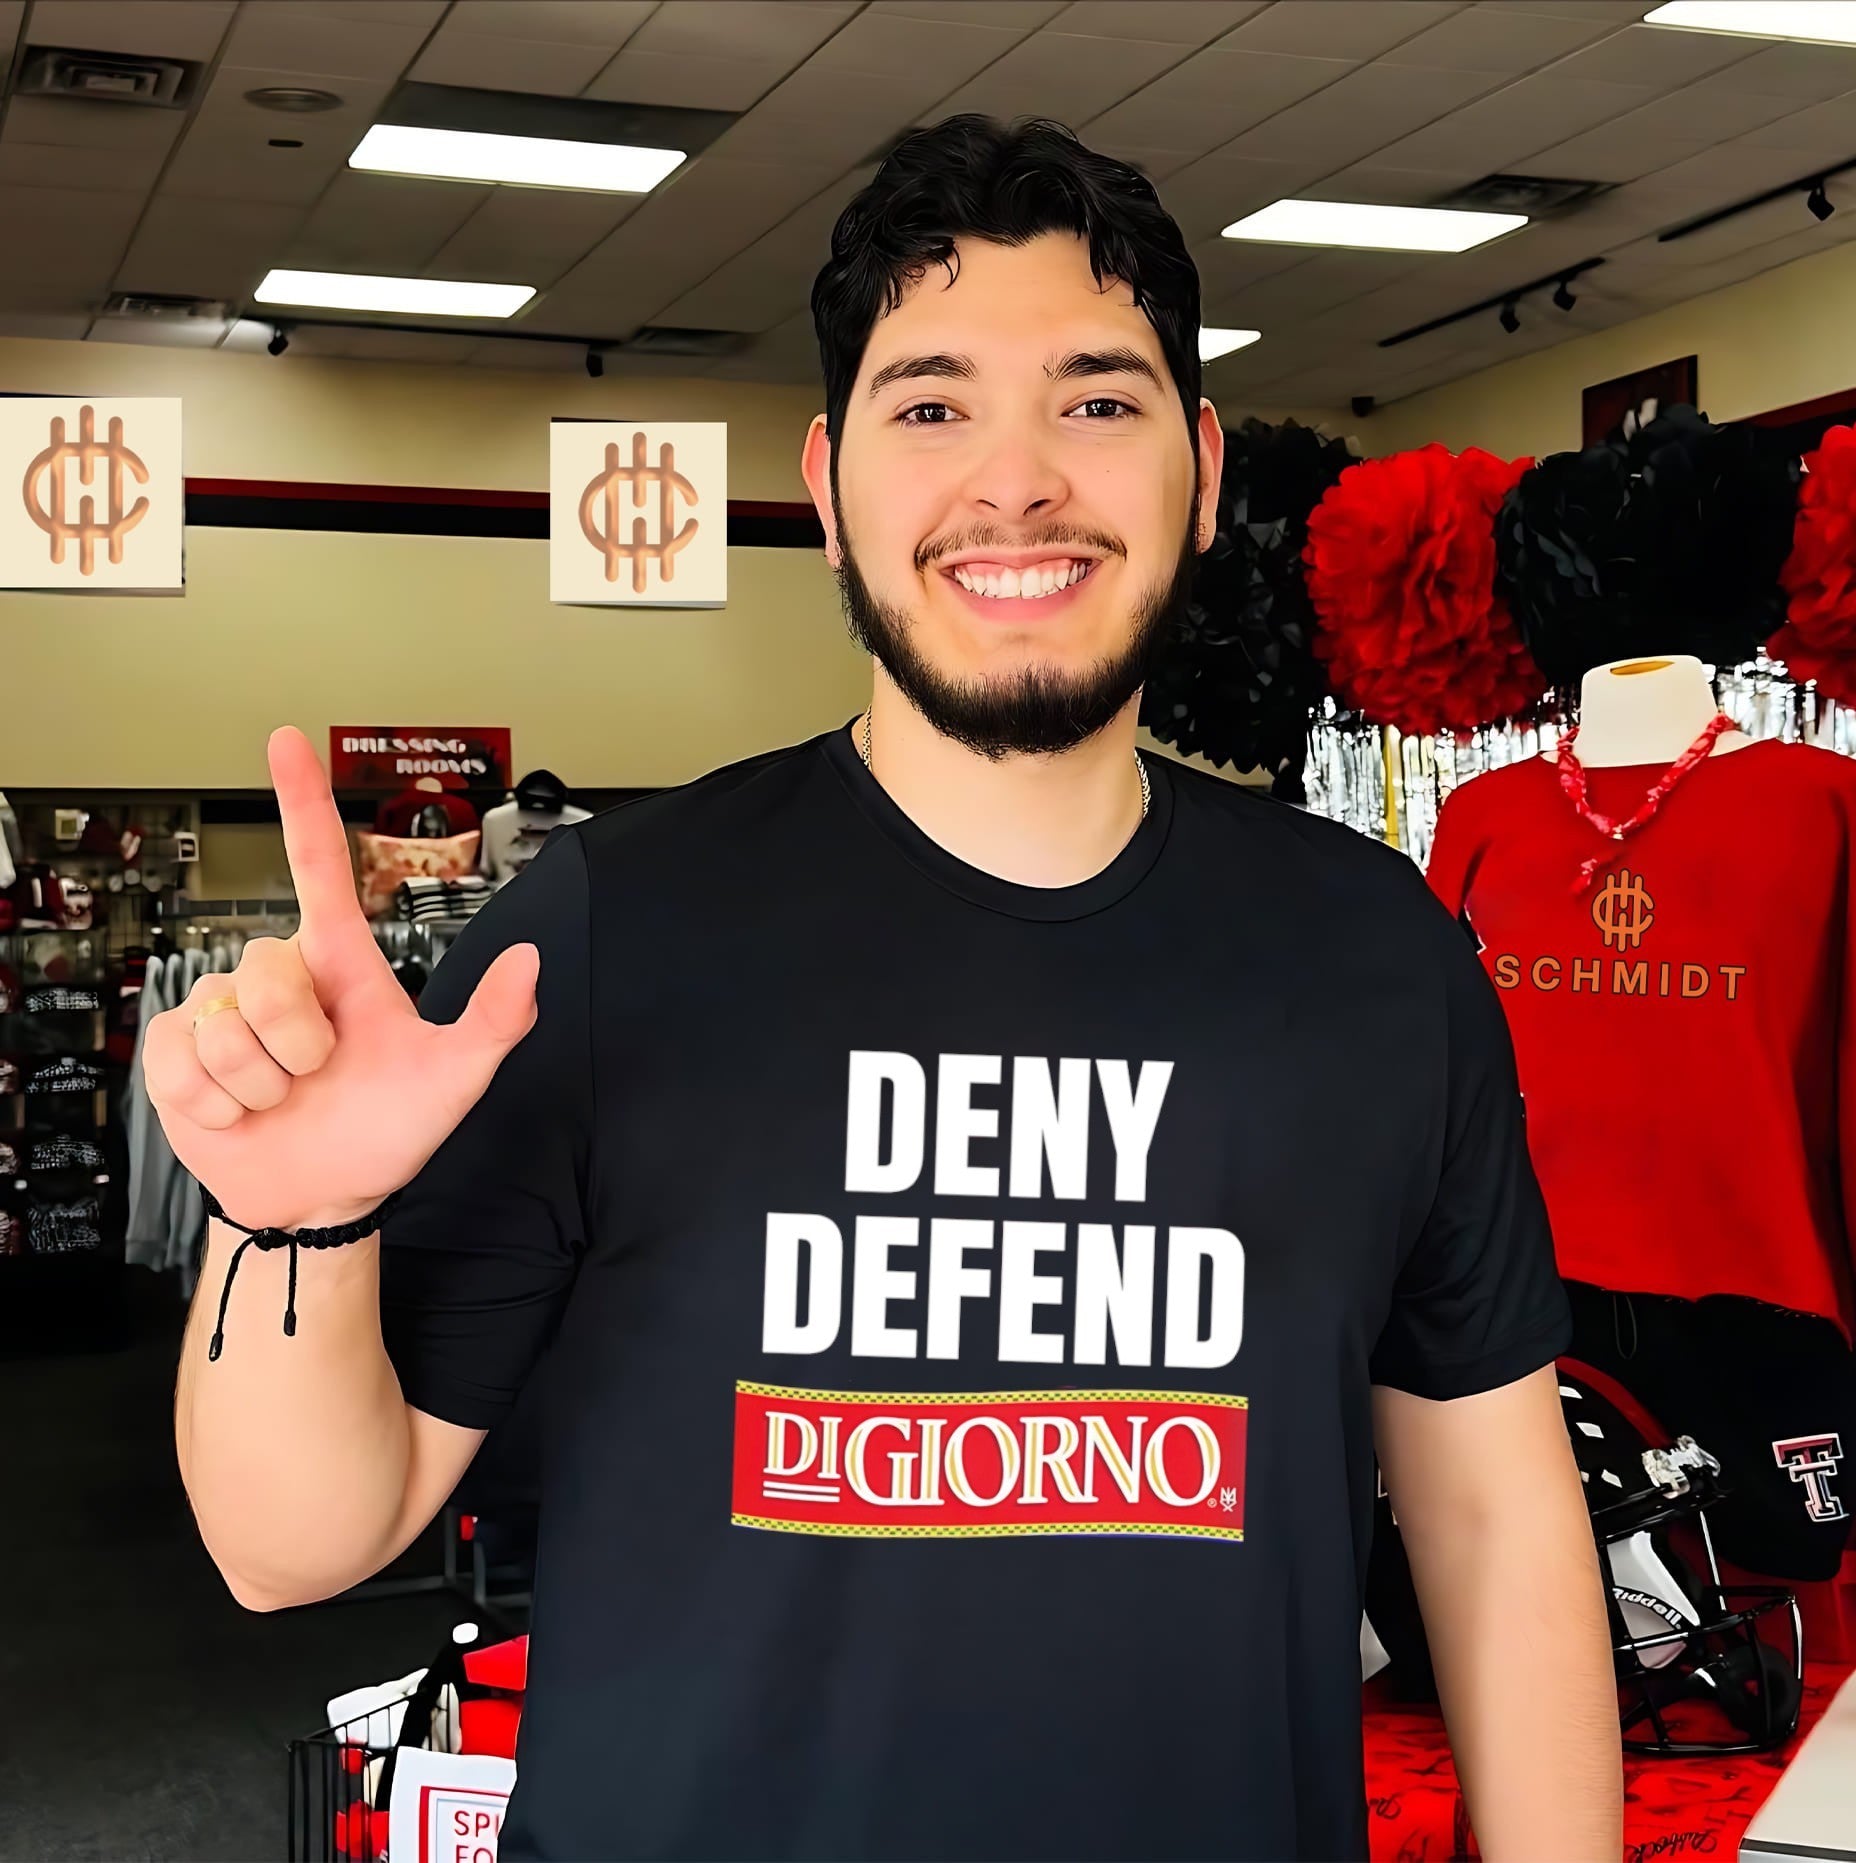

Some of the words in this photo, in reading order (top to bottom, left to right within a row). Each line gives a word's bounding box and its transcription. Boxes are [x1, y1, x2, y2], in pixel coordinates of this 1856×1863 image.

[1494, 954, 1747, 1000] SCHMIDT
[844, 1050, 1175, 1202] DENY
[762, 1212, 1246, 1369] DEFEND
